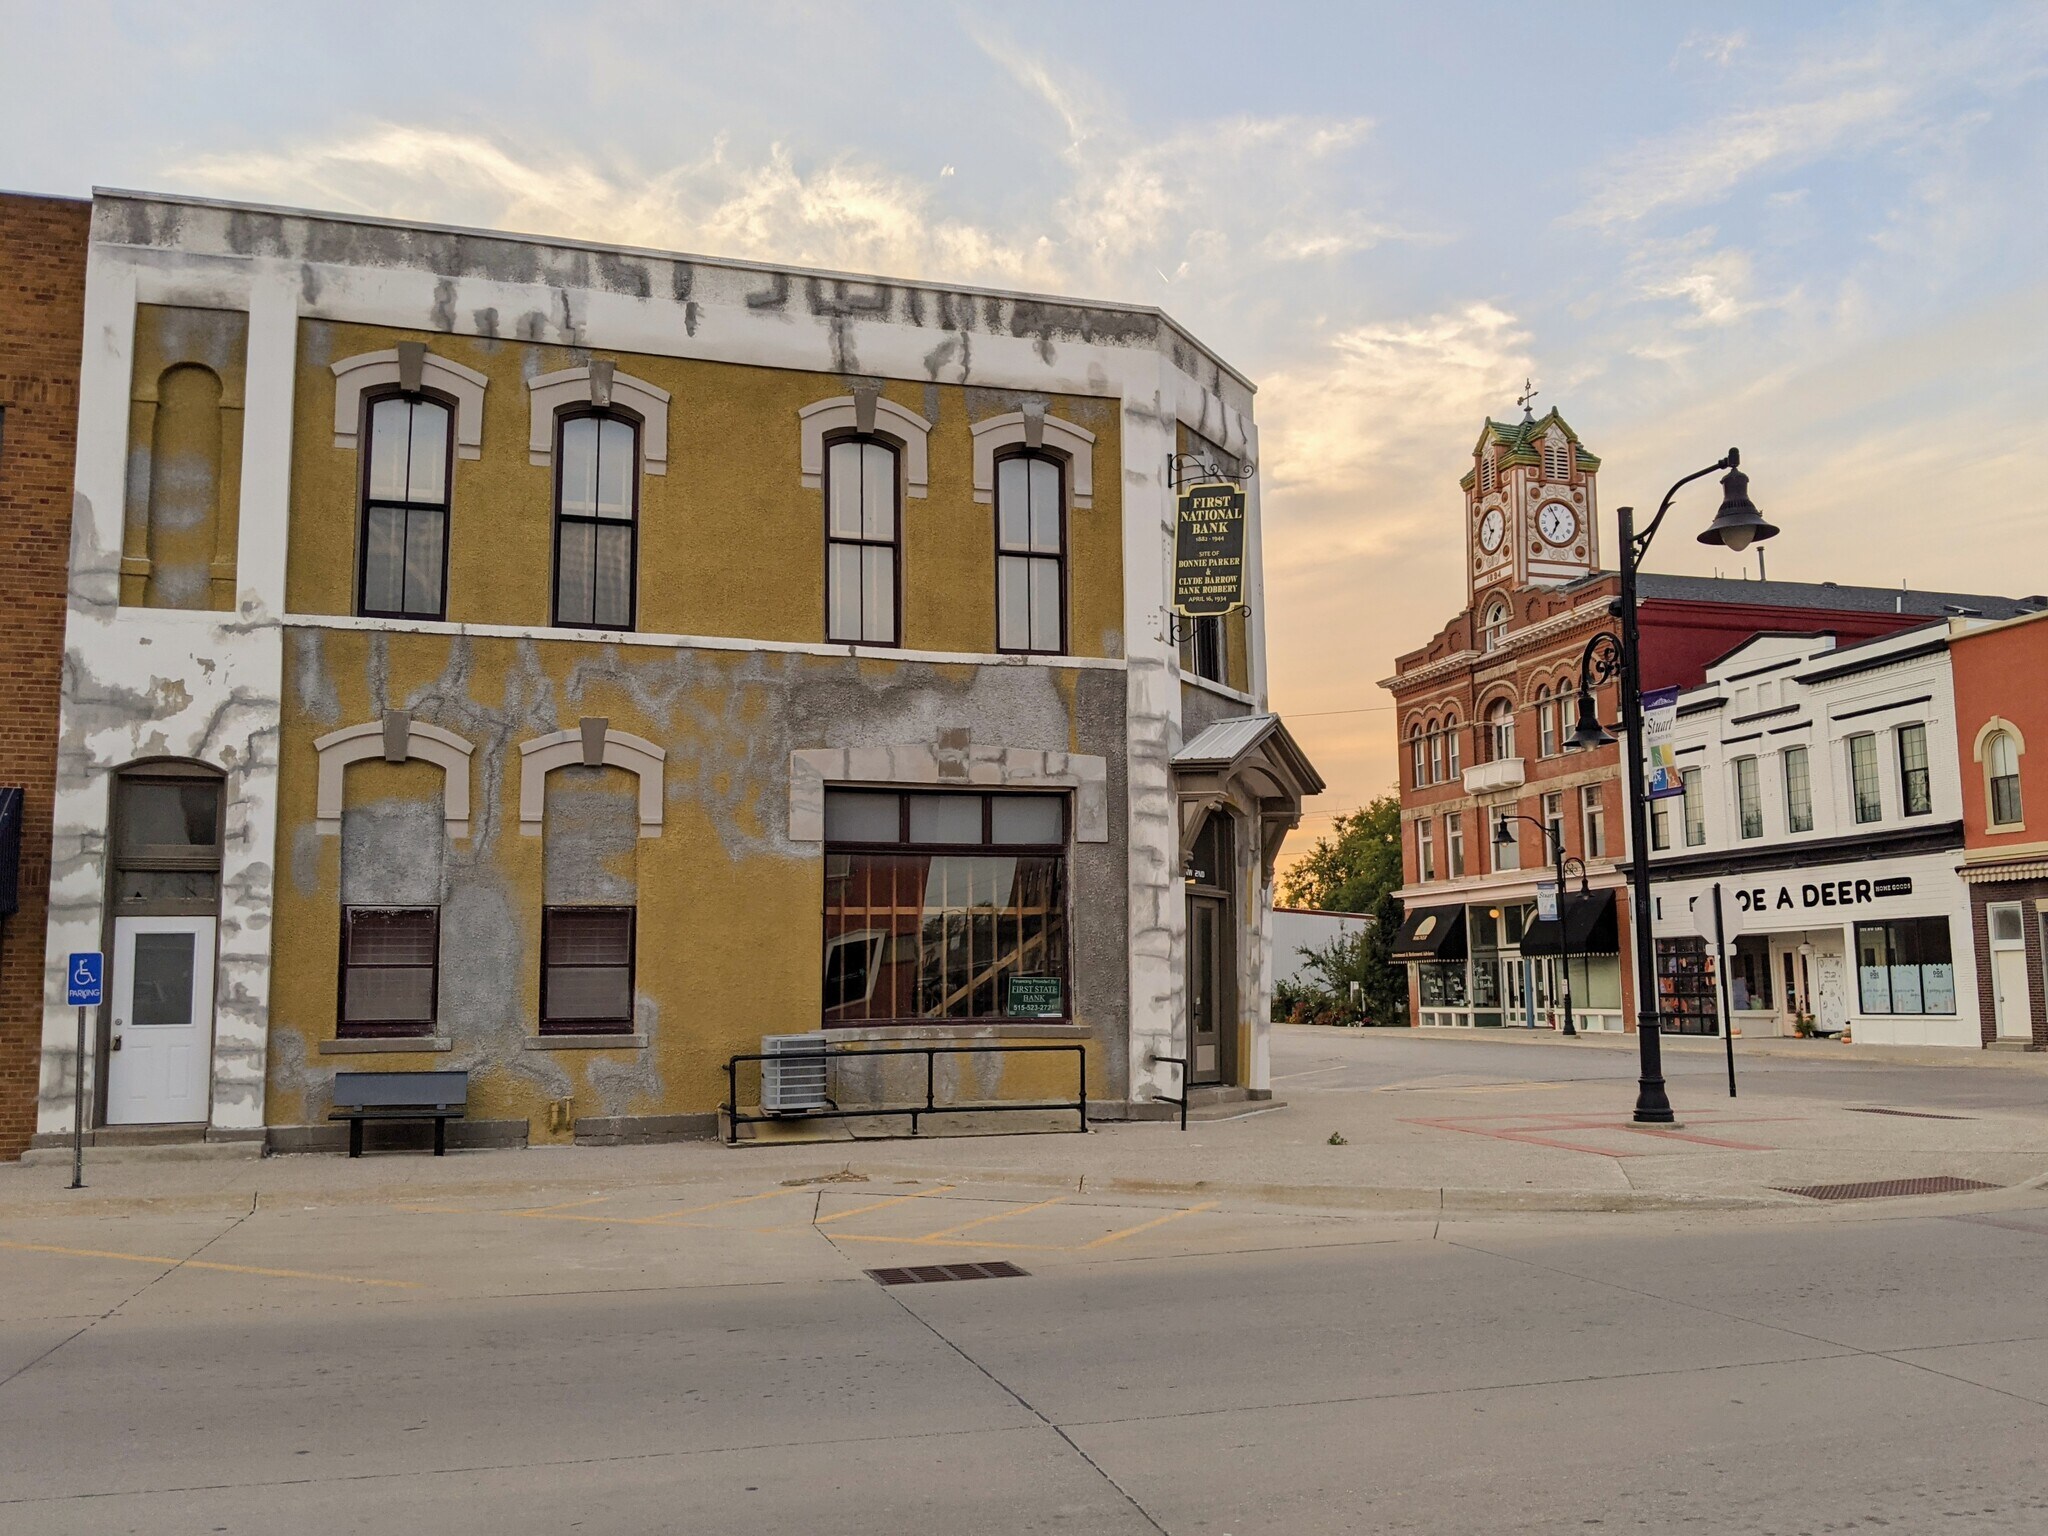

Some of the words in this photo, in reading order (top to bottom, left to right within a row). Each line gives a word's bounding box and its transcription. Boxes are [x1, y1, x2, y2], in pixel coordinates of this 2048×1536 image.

[1193, 496, 1231, 508] FIRST
[1181, 508, 1242, 522] NATIONAL
[1192, 522, 1228, 534] BANK
[1178, 559, 1207, 568] BONNIE
[1208, 557, 1240, 566] PARKER
[1205, 567, 1211, 576] &
[1178, 577, 1203, 585] CLYDE
[1204, 575, 1238, 584] BARROW
[1178, 586, 1200, 595] BANK
[1202, 584, 1238, 594] ROBBERY
[1647, 717, 1673, 735] Stuart
[1875, 884, 1891, 892] HOME
[1891, 882, 1911, 891] GOODS
[1735, 888, 1767, 912] OE
[1776, 886, 1794, 910] A
[1802, 879, 1872, 908] DEER
[69, 989, 100, 997] PARKING
[1011, 985, 1034, 993] FIRST
[1034, 985, 1058, 993] STATE
[1023, 994, 1046, 1003] BANK
